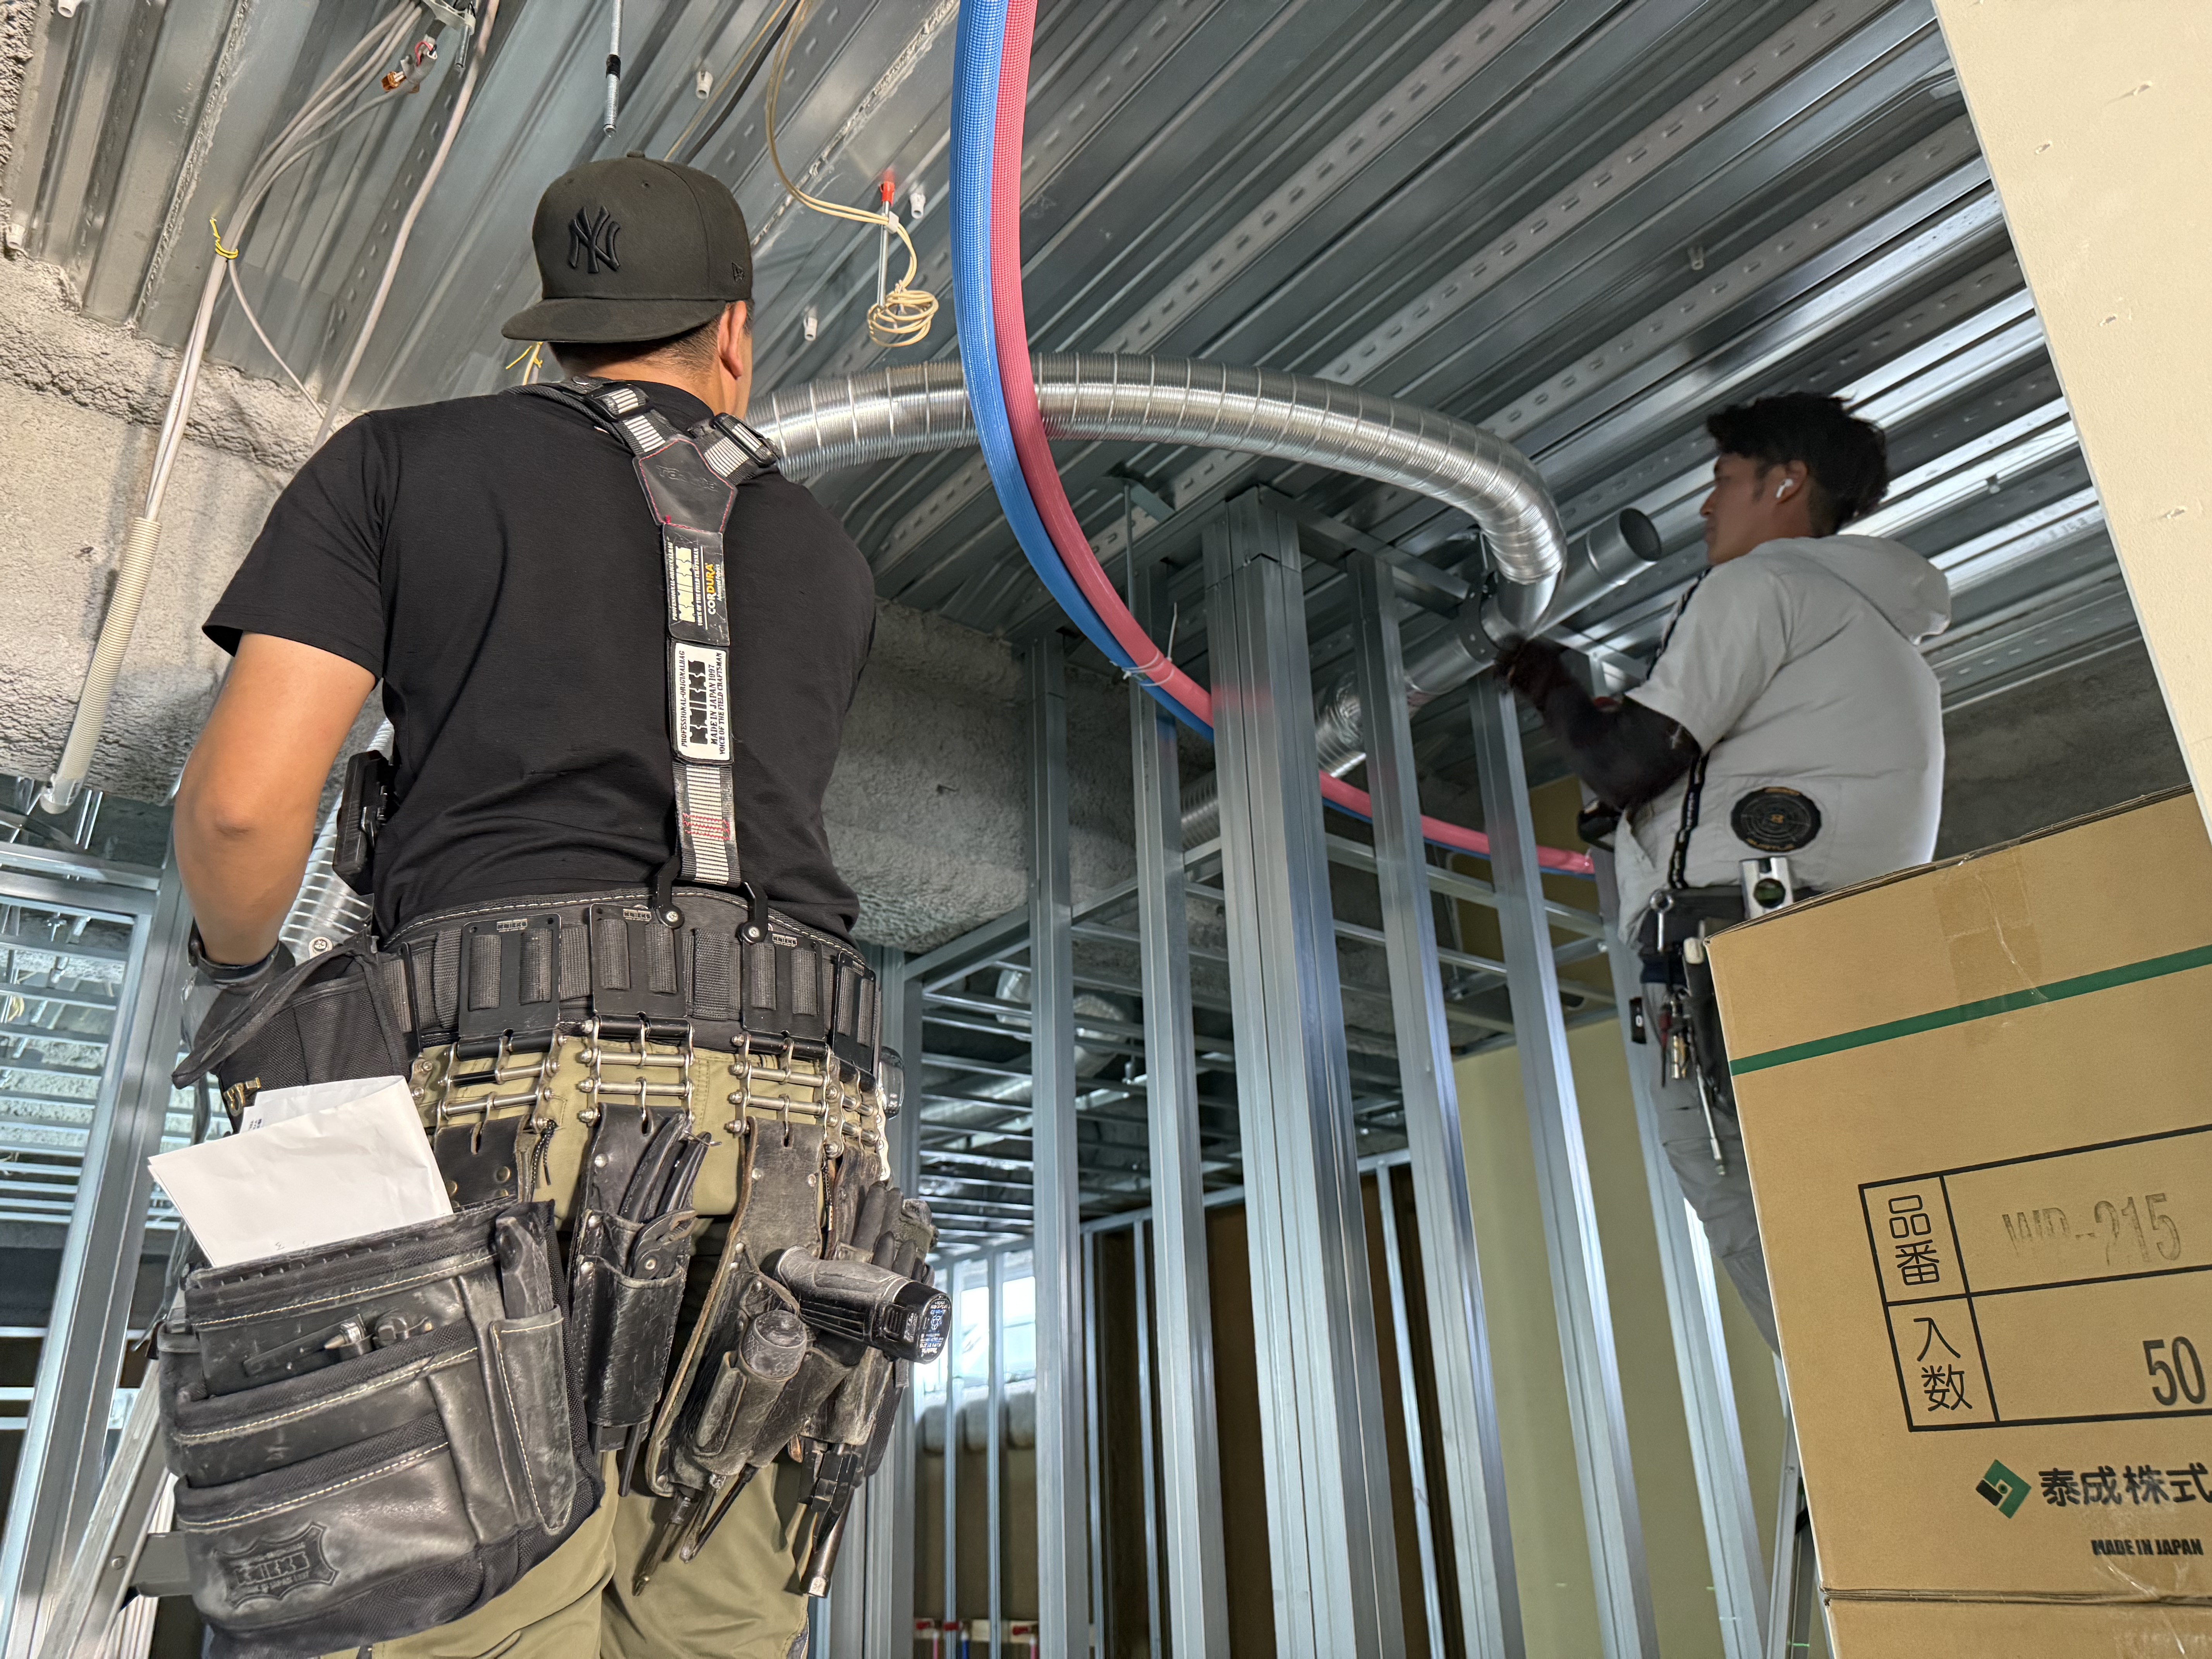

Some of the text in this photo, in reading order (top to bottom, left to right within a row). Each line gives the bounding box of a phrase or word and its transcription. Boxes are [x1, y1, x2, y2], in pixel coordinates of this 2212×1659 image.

[567, 205, 621, 274] NY
[708, 664, 716, 681] 1997
[709, 682, 717, 709] JAPAN
[709, 710, 717, 720] IN
[718, 726, 725, 735] OF
[1888, 1194, 1940, 1286] 品番
[1913, 1316, 1973, 1412] 入数
[2142, 1336, 2207, 1407] 50
[2038, 1462, 2212, 1507] 泰成株式
[2090, 1538, 2204, 1556] MADE IN JAPAN
